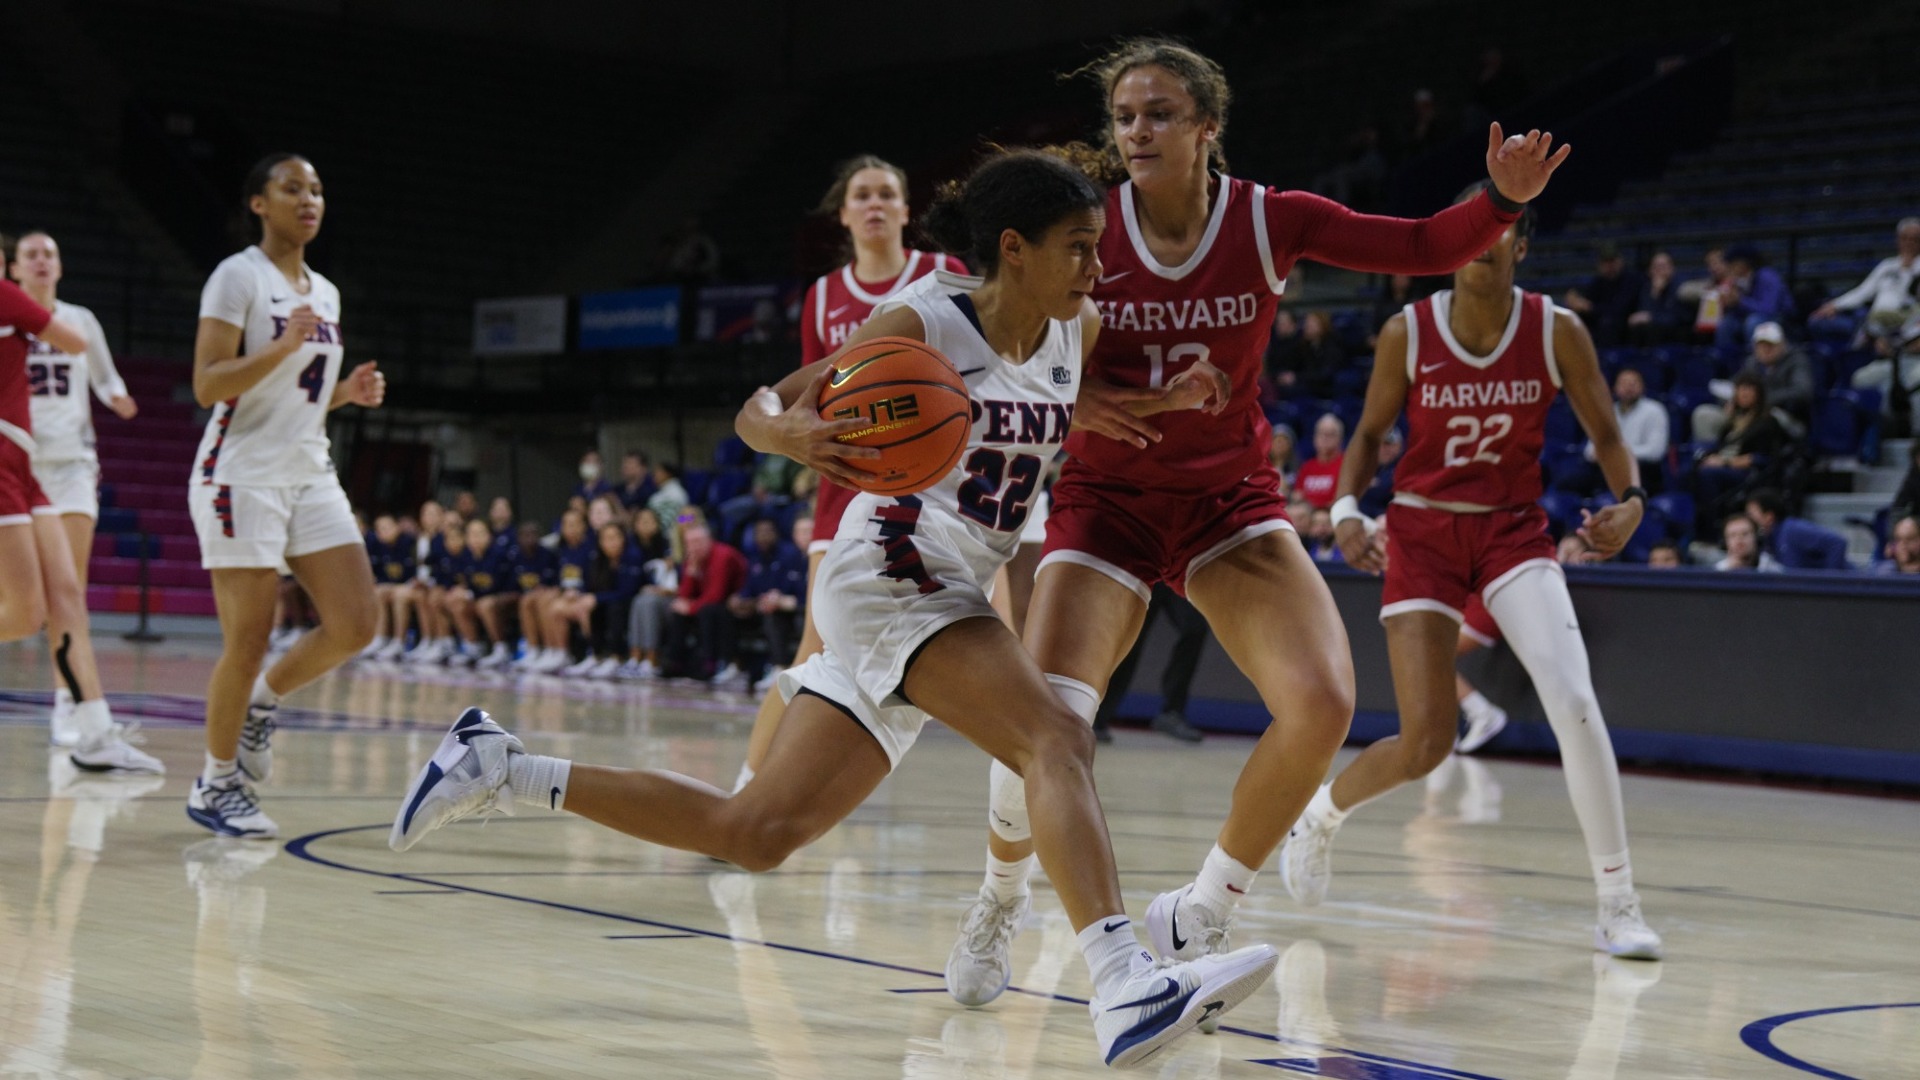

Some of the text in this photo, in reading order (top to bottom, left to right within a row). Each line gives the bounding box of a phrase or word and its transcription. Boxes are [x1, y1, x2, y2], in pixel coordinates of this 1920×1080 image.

[1095, 293, 1257, 331] HARVARD
[28, 364, 71, 396] 25
[298, 354, 328, 403] 4
[1421, 379, 1542, 408] HARVARD
[1444, 413, 1514, 467] 22
[957, 446, 1042, 532] 22
